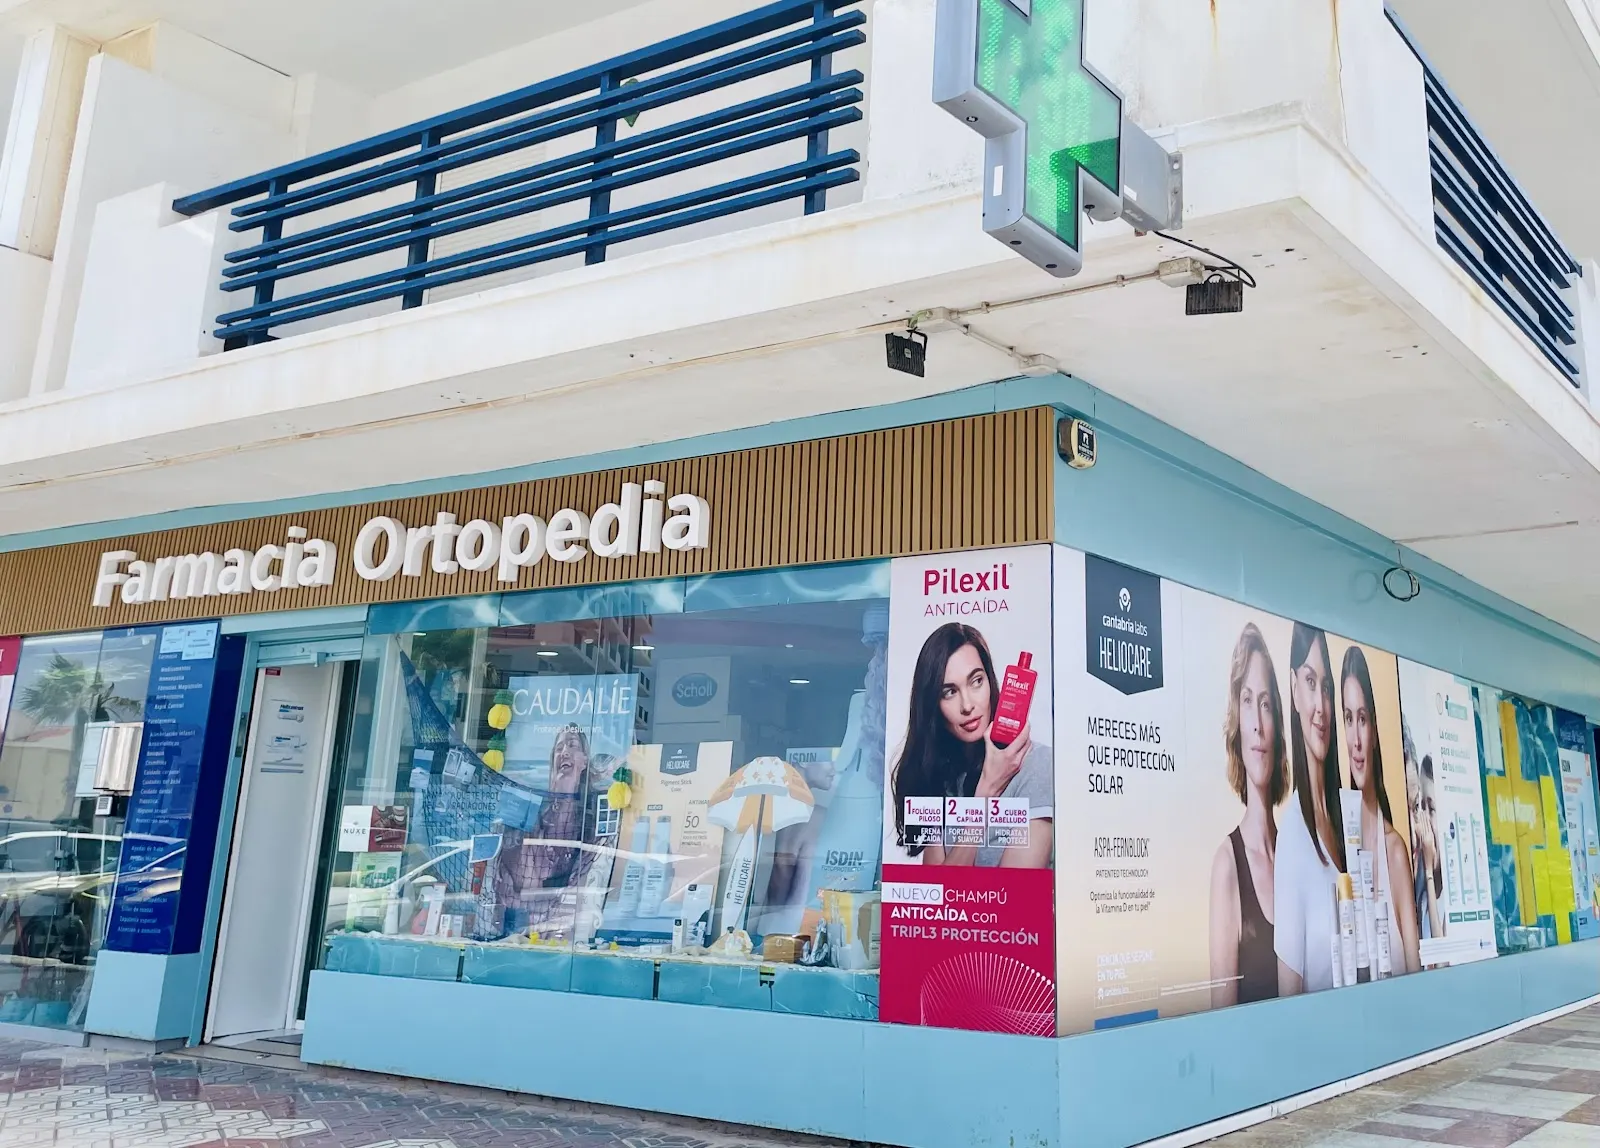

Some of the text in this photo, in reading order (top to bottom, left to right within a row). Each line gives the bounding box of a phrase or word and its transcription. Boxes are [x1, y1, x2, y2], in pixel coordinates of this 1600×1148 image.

[92, 479, 710, 607] Farmacia Ortopedia
[924, 564, 1009, 595] Pilexil
[924, 597, 1009, 617] ANTICAÍDA
[1102, 614, 1148, 637] cantabria labs
[1099, 635, 1152, 679] HELIOCARE
[676, 680, 712, 698] Scholl
[1006, 678, 1030, 690] Pilexil
[1088, 716, 1160, 744] MERECES MÁS
[666, 760, 690, 770] HELIOCARE
[789, 752, 816, 763] ISDIN
[1088, 744, 1174, 772] QUE PROTECCIÓN
[1088, 773, 1124, 794] SOLAR
[906, 799, 911, 814] 1
[912, 806, 941, 815] FOLÍCULO
[948, 800, 957, 815] 2
[991, 800, 999, 816] 3
[684, 816, 699, 828] 50
[949, 828, 983, 836] FORTALECE
[826, 850, 864, 866] ISDIN
[733, 858, 753, 905] HELIOCARE
[1096, 869, 1149, 878] PATENTED TECHNOLOGY
[892, 887, 1007, 904] NUEVO CHAMPÚ
[890, 904, 998, 923] ANTICAÍDA con
[890, 925, 1039, 945] TRIPL3 PROTECCIÓN
